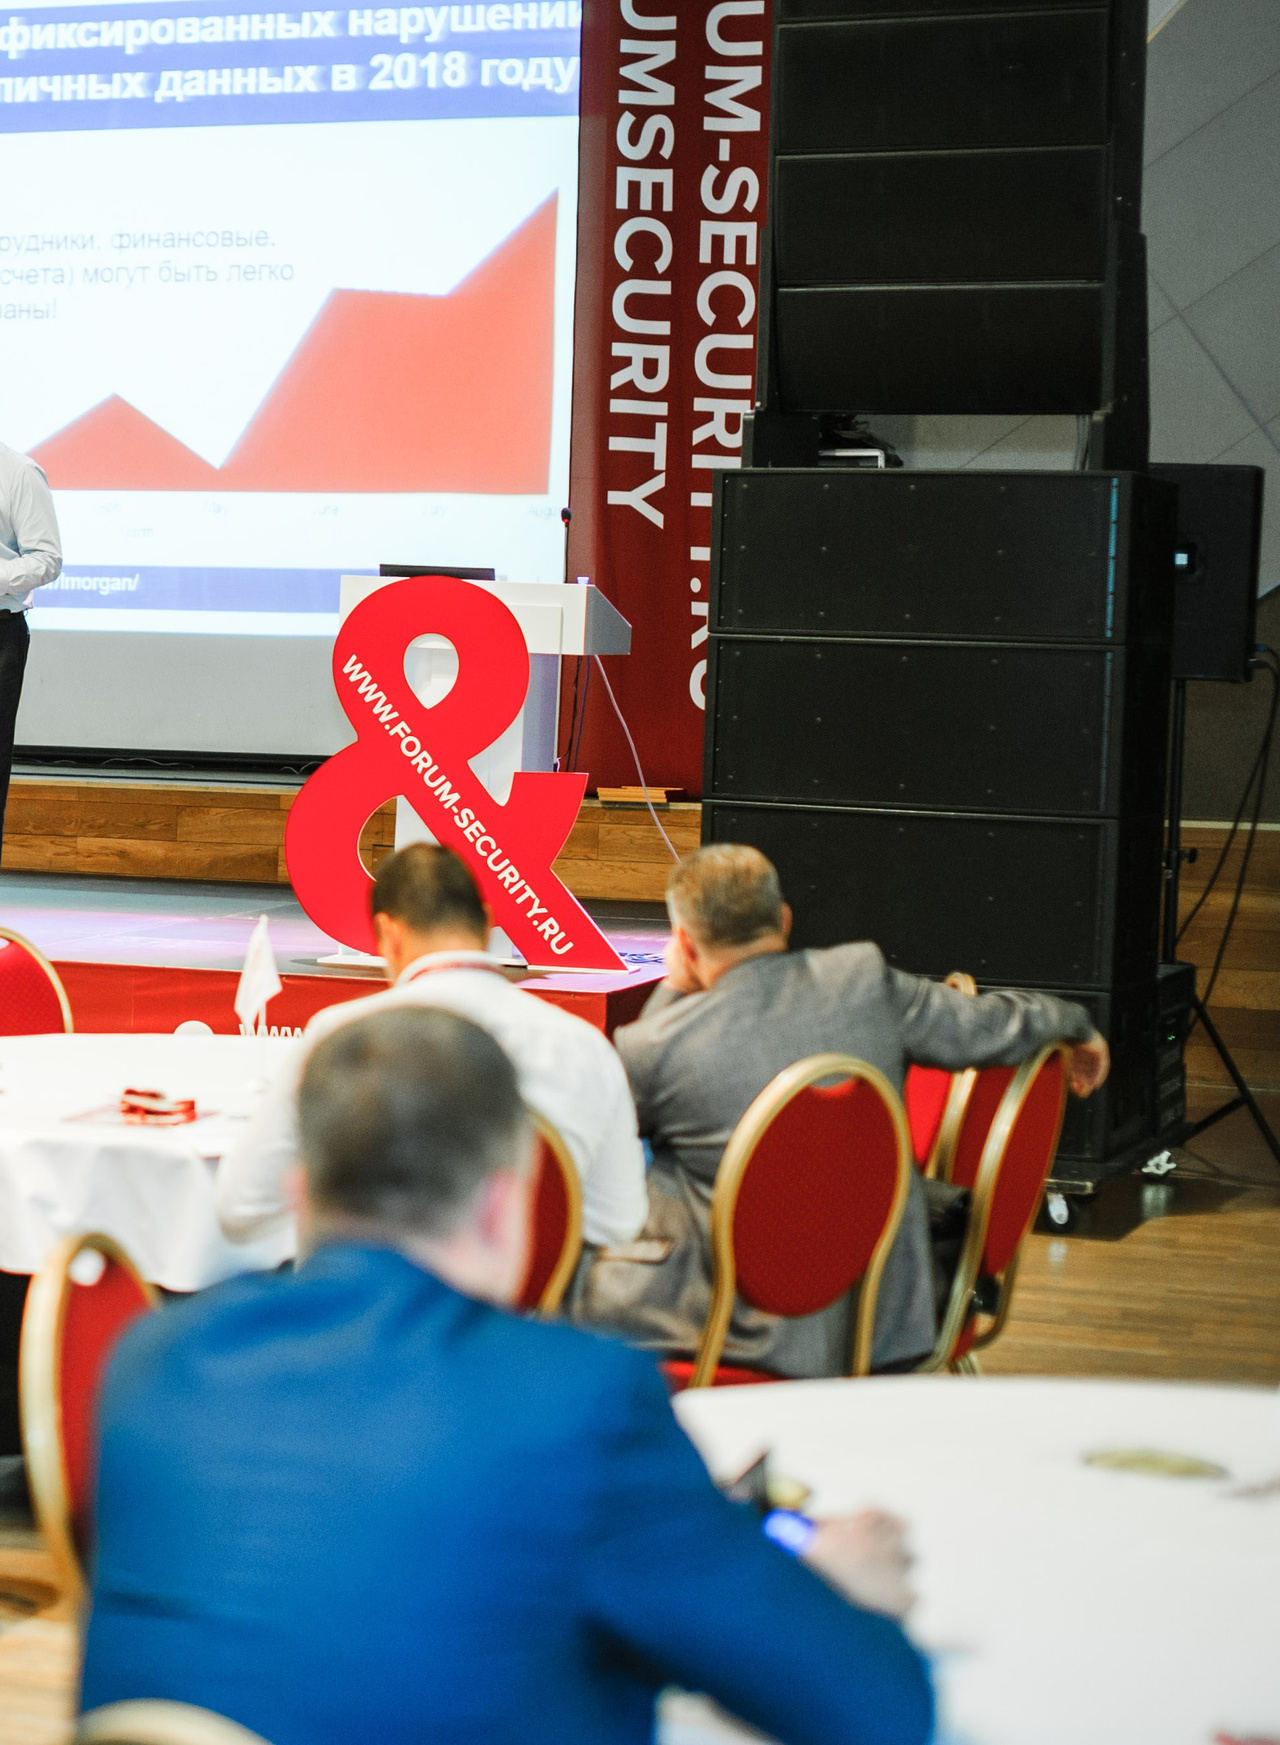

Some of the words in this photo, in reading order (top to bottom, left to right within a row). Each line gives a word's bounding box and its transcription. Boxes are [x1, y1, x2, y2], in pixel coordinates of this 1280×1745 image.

[153, 63, 318, 102] данных
[331, 64, 356, 91] в
[368, 51, 467, 91] 2018
[480, 55, 581, 95] году
[83, 266, 152, 289] могут
[158, 260, 219, 283] быть
[226, 263, 295, 283] легко
[342, 653, 574, 956] WWW.FORUM-SECURITY.RU
